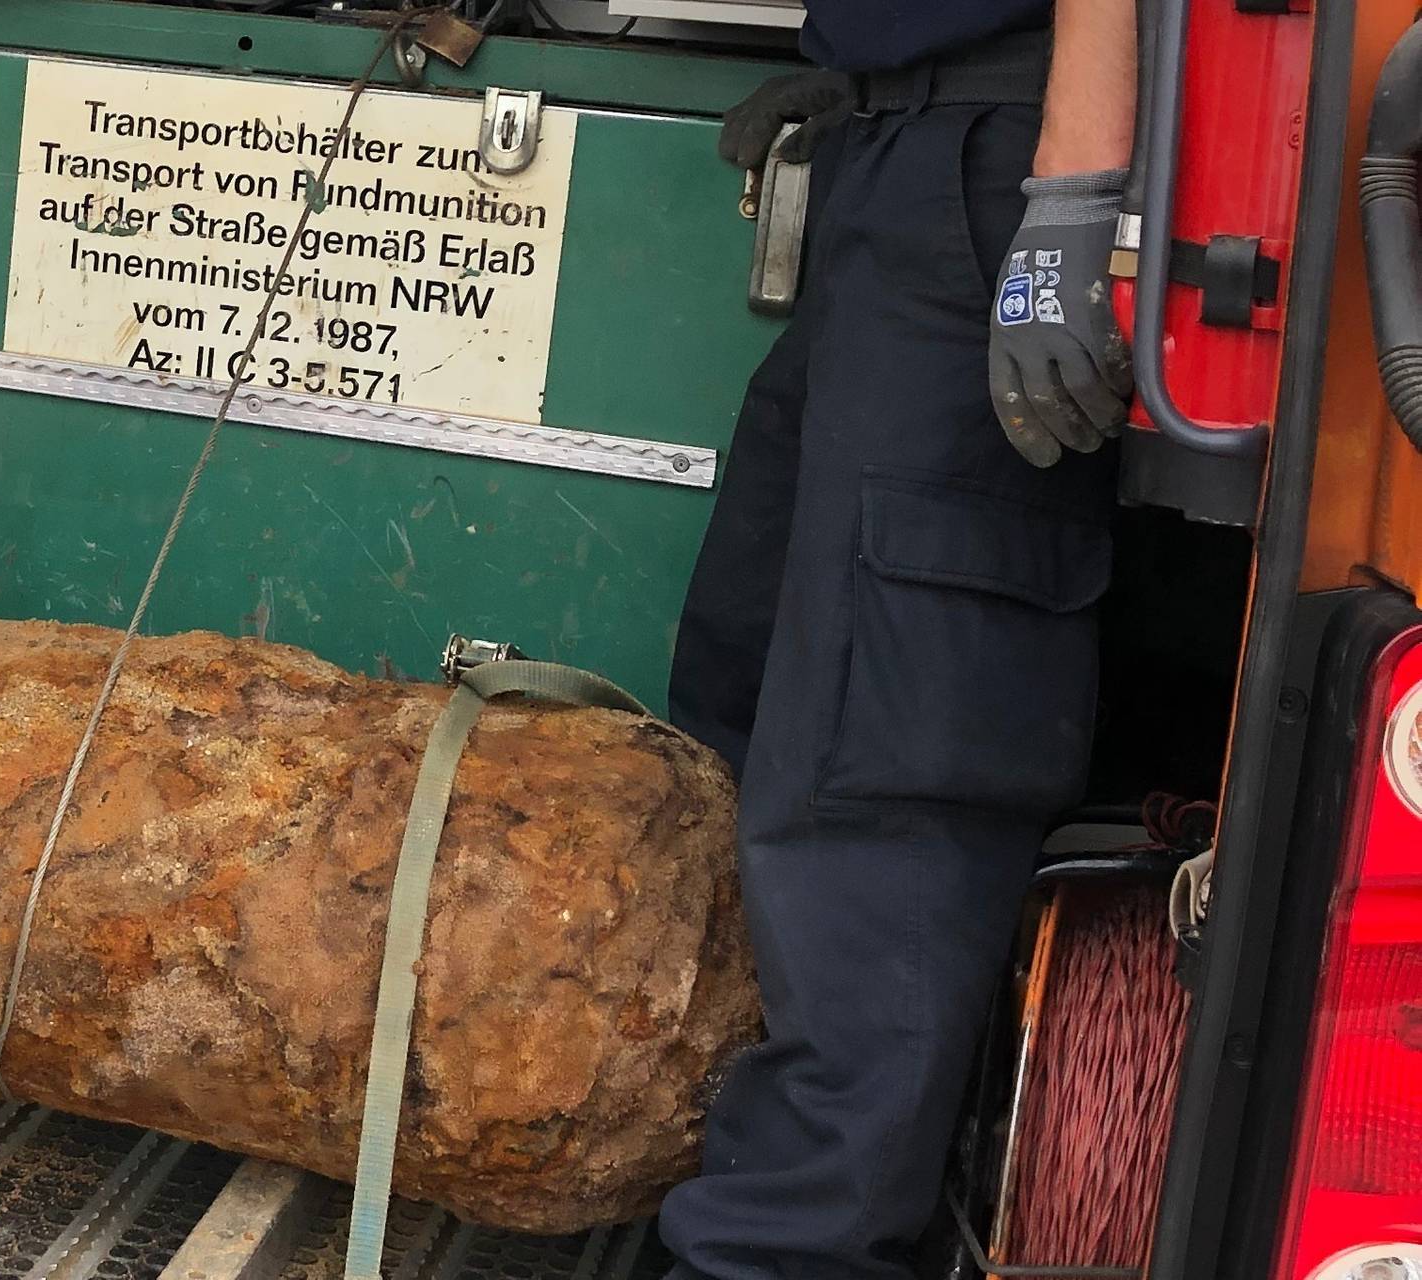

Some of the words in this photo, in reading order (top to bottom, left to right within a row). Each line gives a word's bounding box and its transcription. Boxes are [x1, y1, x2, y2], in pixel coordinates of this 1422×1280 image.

[84, 99, 404, 165] Transportbehälter
[38, 140, 205, 193] Transport
[214, 170, 278, 200] von
[38, 193, 95, 224] auf
[103, 196, 161, 232] der
[169, 202, 288, 247] Straße
[299, 227, 427, 264] gemäß
[438, 233, 536, 276] Erlaß
[70, 237, 378, 306] Innenministerium
[390, 275, 496, 320] NRW
[132, 301, 206, 332] vom
[219, 303, 242, 337] 7.
[314, 316, 400, 362] 1987,
[127, 338, 182, 375] Az:
[227, 350, 257, 384] C
[266, 356, 403, 404] 3-5.571
